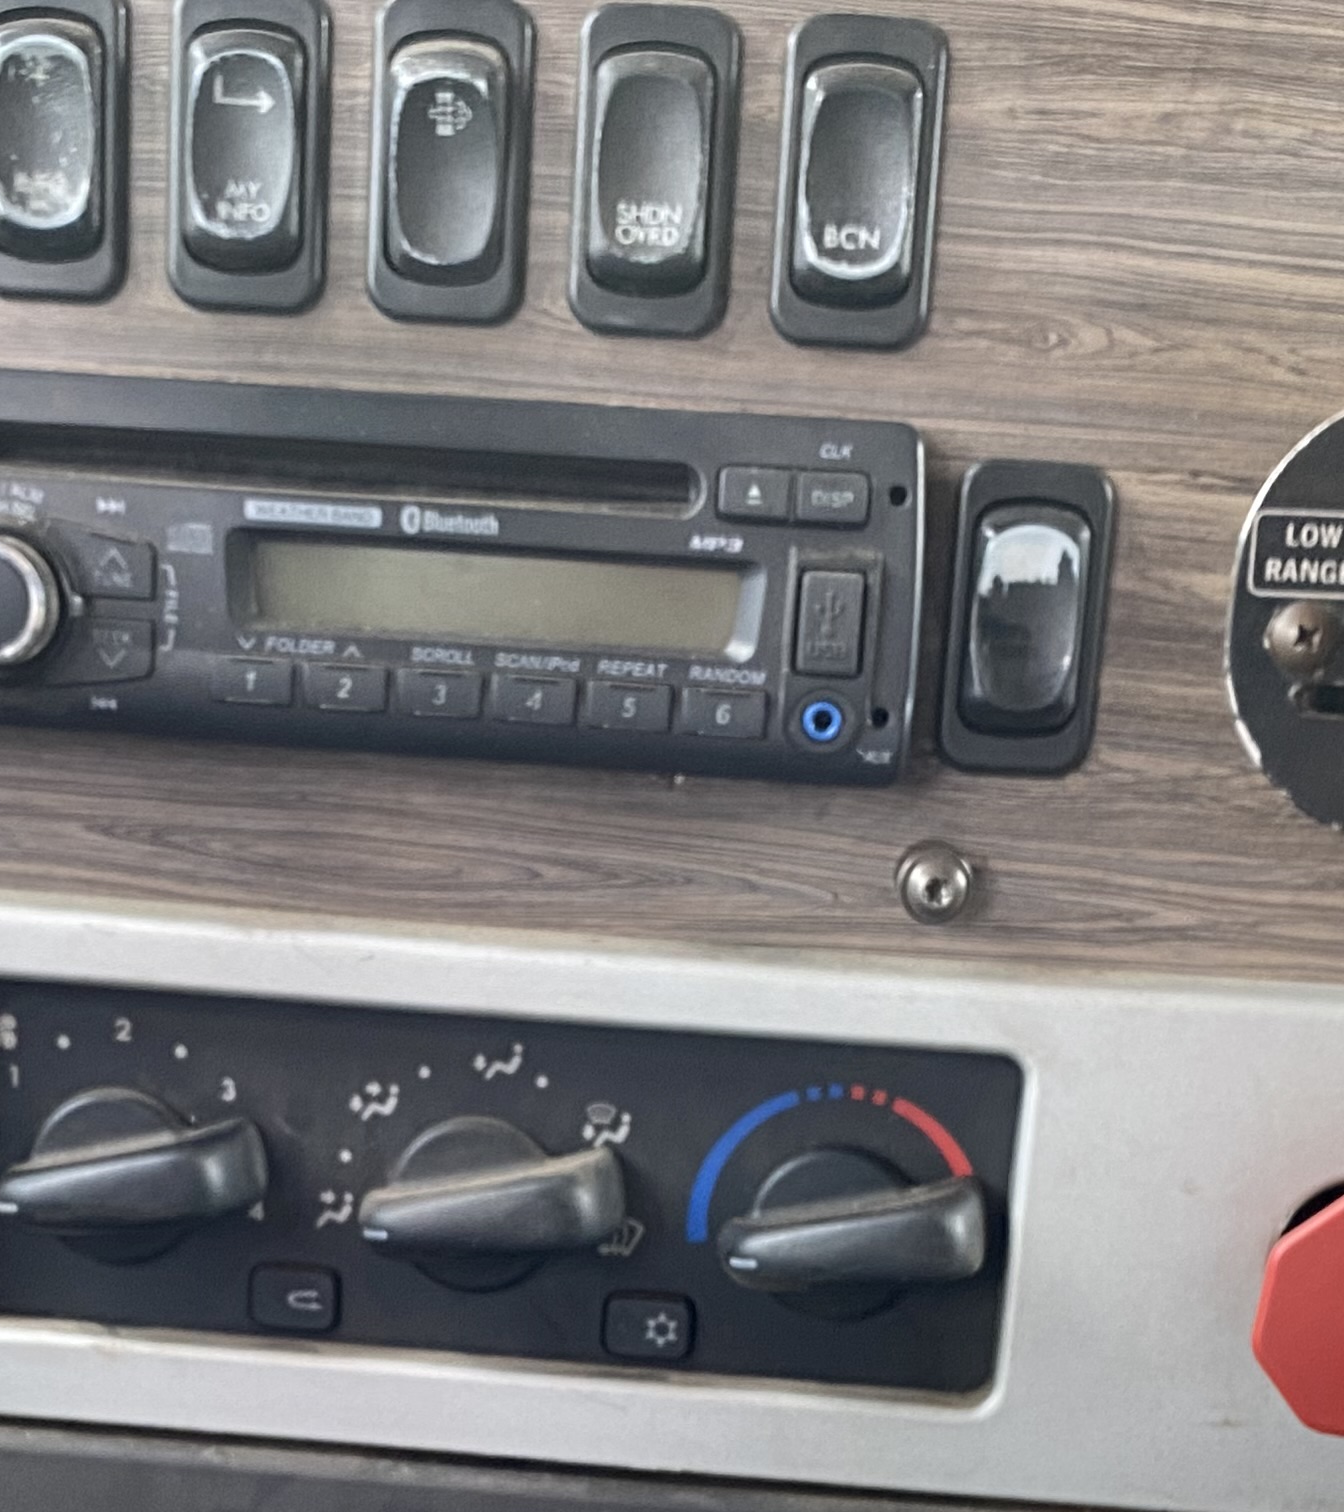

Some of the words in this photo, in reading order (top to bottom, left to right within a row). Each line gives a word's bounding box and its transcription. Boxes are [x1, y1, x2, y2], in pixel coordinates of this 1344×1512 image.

[823, 223, 881, 251] BCN
[422, 509, 500, 536] Bluetooth
[1285, 522, 1343, 548] LOW
[264, 635, 337, 654] FOLDER
[411, 646, 474, 666] SCROLL
[597, 659, 669, 678] REPEAT
[688, 664, 767, 686] RANDOM
[245, 670, 257, 691] 1
[336, 677, 353, 698] 2
[432, 684, 448, 705] 3
[525, 689, 543, 710] 4
[622, 697, 636, 718] 5
[715, 703, 731, 725] 6
[114, 1017, 132, 1042] 2
[9, 1064, 20, 1088] 1
[221, 1076, 237, 1101] 3
